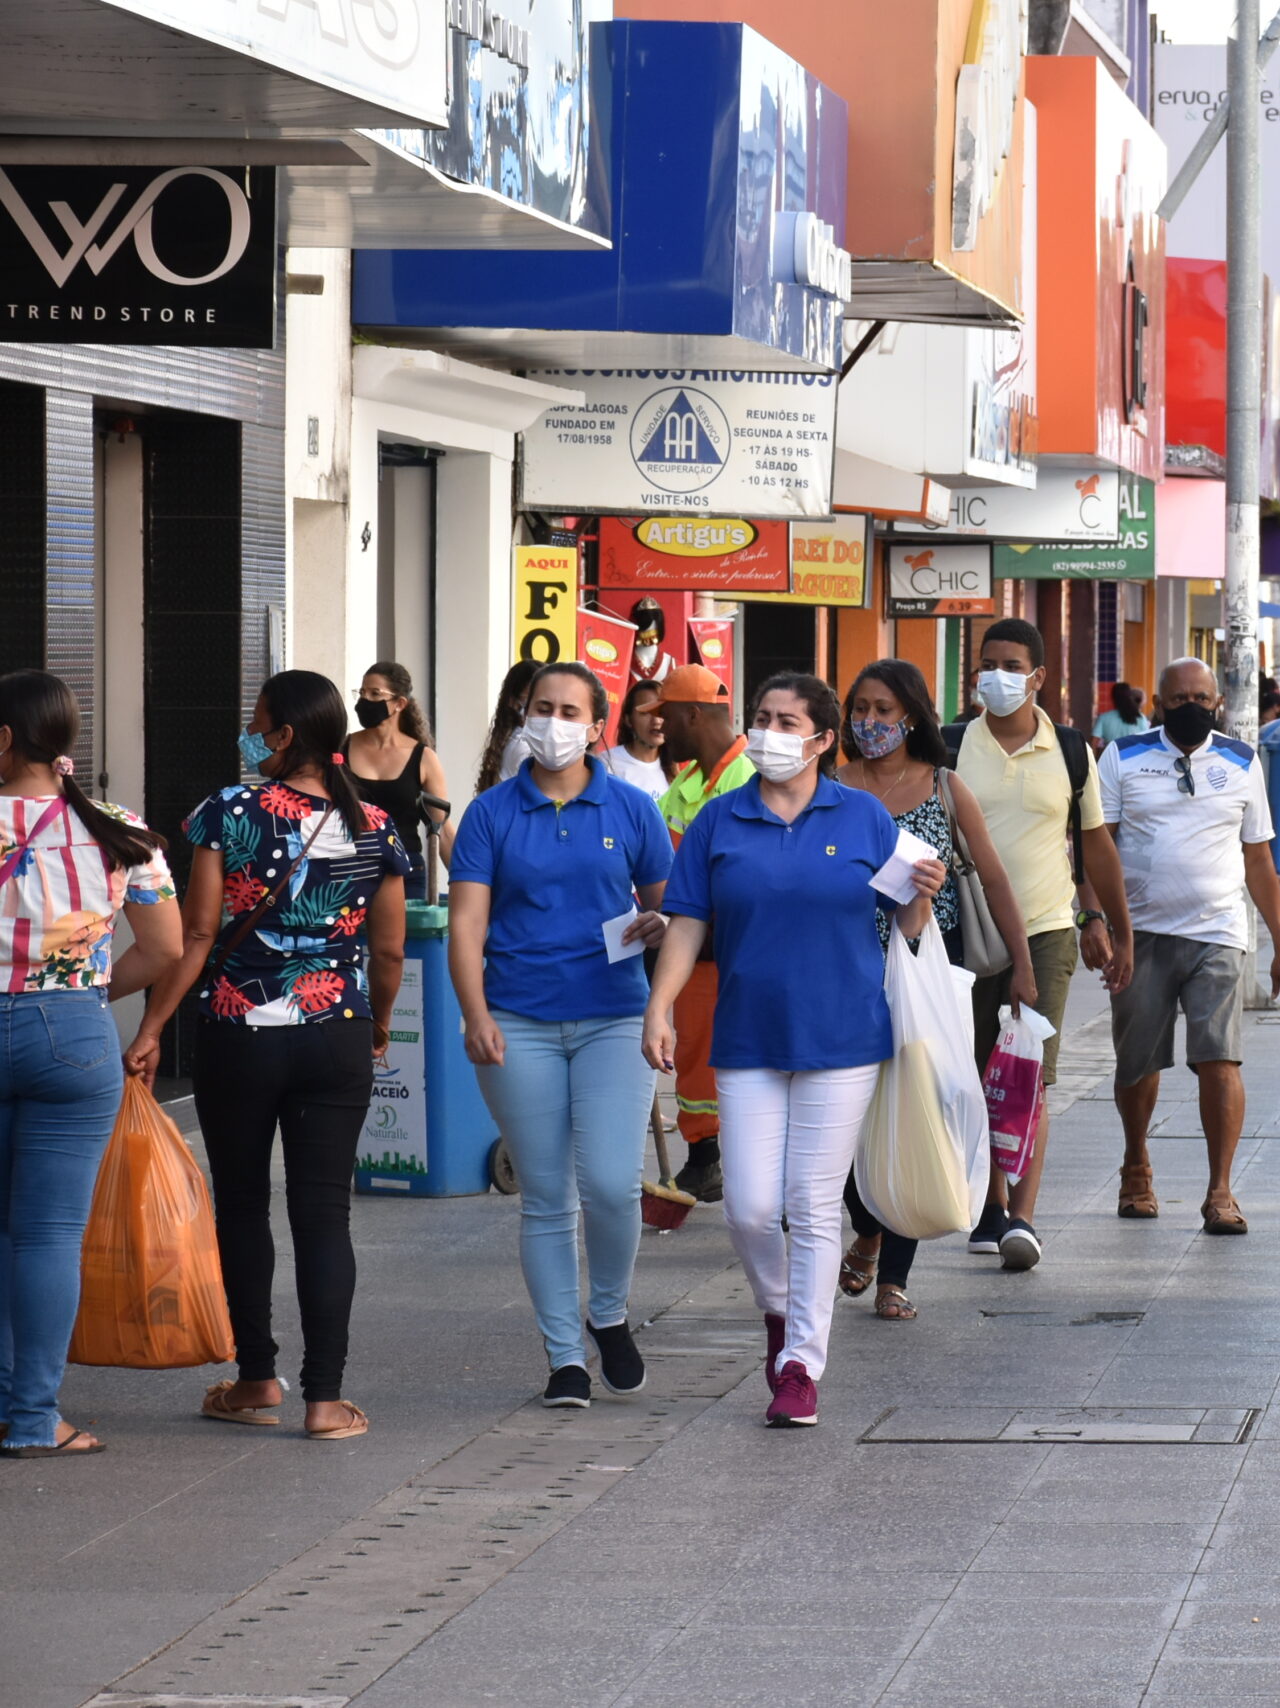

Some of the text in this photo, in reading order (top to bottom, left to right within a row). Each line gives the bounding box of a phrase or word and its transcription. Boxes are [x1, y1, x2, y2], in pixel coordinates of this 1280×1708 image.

[1158, 90, 1210, 105] erva
[7, 304, 217, 323] TREND STORE
[545, 419, 615, 430] FUNDADO EM
[640, 405, 667, 444] UNIDADE
[695, 405, 720, 444] SERVIÇO
[802, 413, 816, 423] DE
[557, 434, 612, 445] 17/08/1958
[664, 412, 697, 460] AA
[733, 428, 828, 442] SEGUNDA A SEXTA
[749, 446, 761, 455] 17
[781, 447, 793, 457] 19
[647, 464, 713, 475] RECUPERAÇÃO
[748, 476, 760, 486] 10
[780, 478, 792, 488] 12
[794, 479, 809, 489] HS
[641, 494, 709, 507] VISITE-NOS
[646, 522, 747, 550] Artigu's
[793, 538, 865, 565] REI DO
[525, 558, 569, 570] AQUI
[910, 566, 980, 595] CHIC
[895, 602, 915, 612] Preço
[916, 602, 927, 611] R$
[392, 1032, 417, 1042] PARTE
